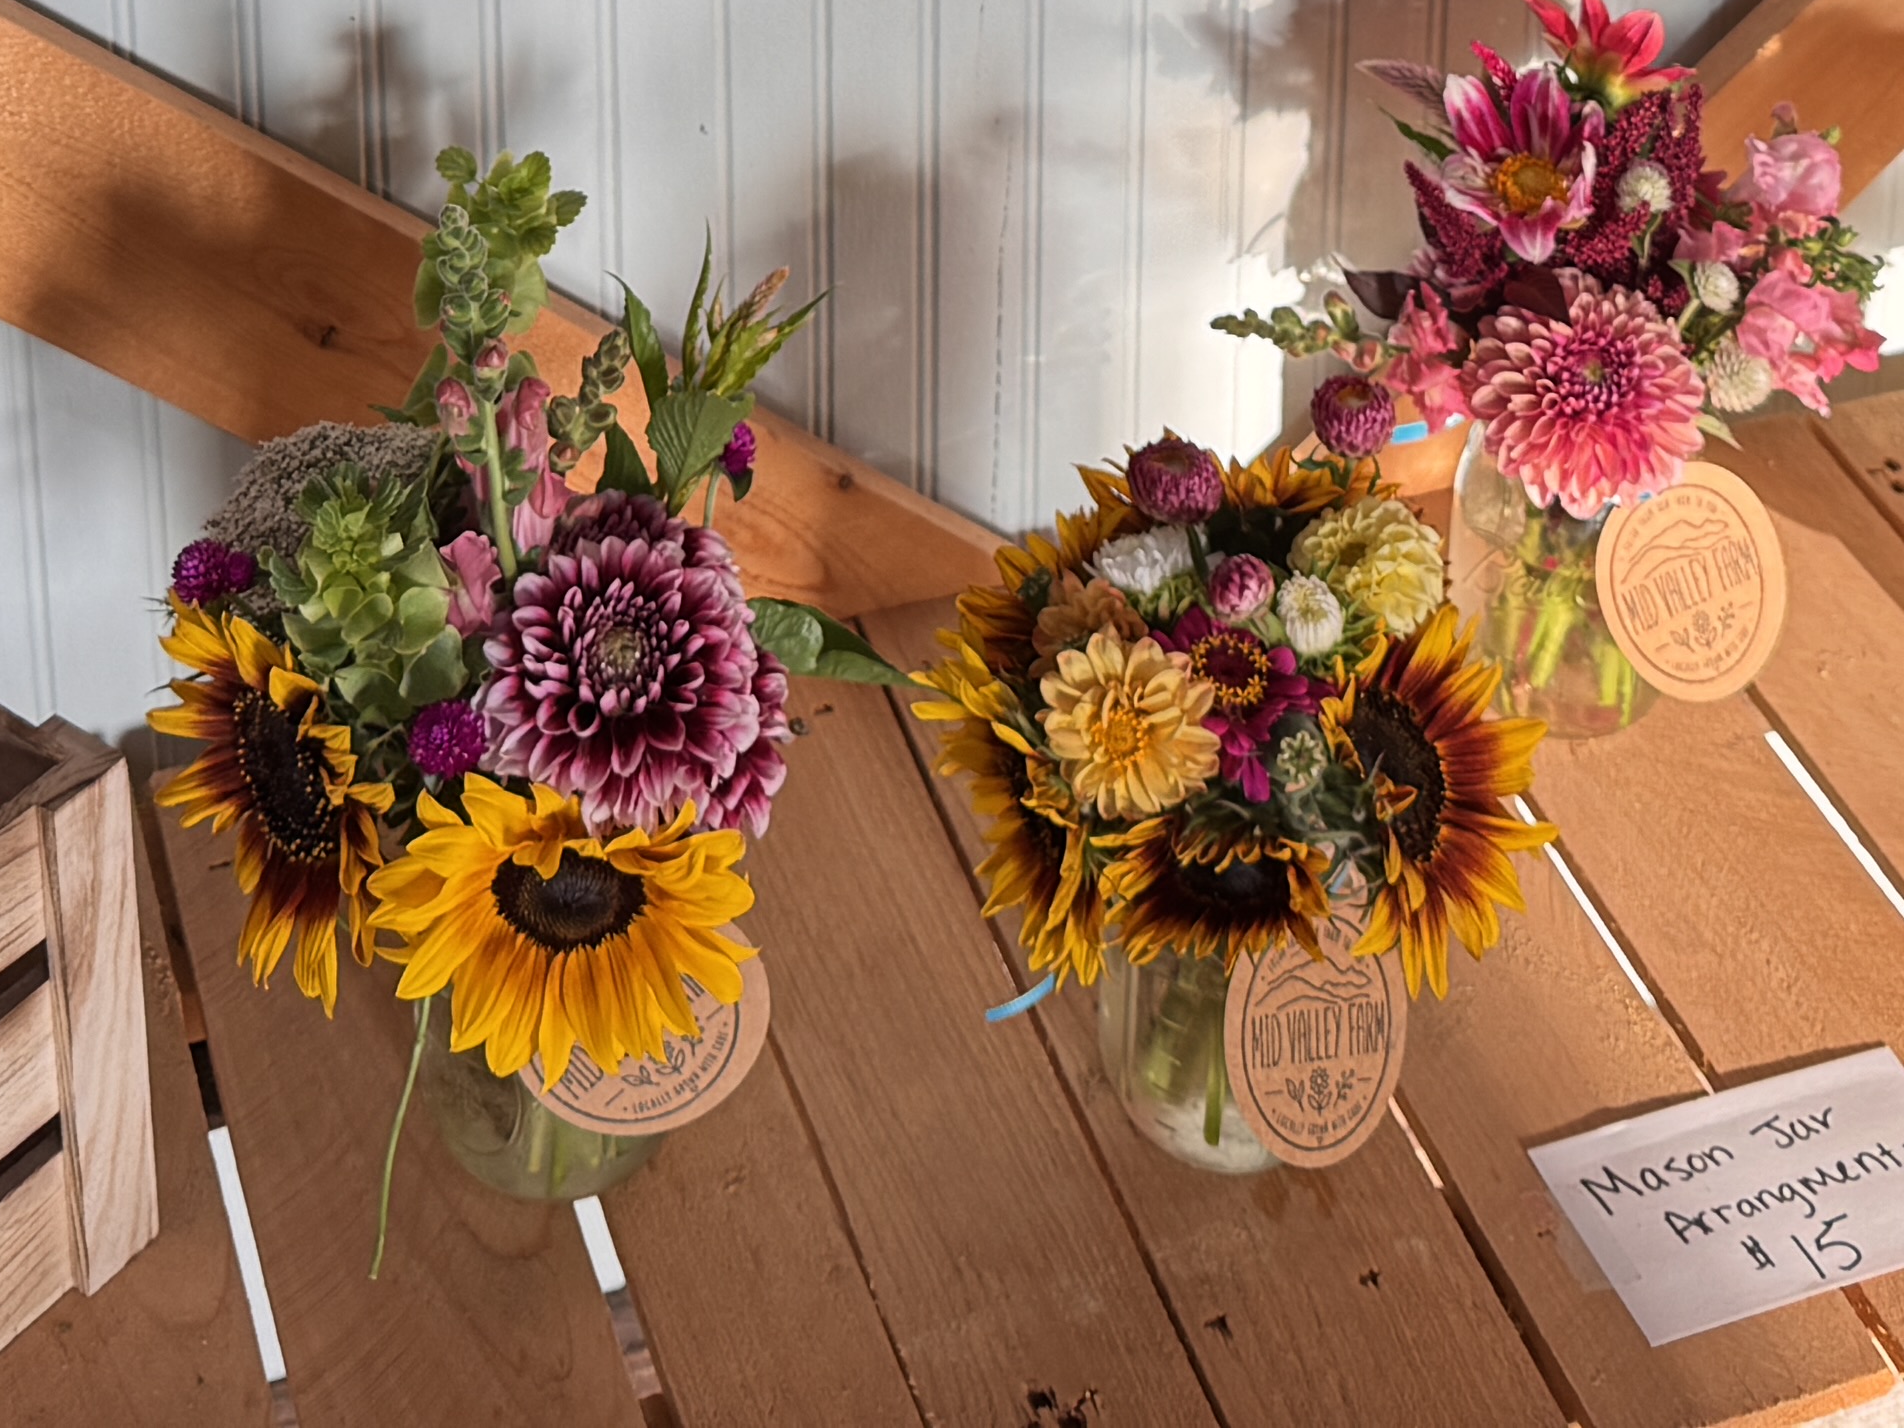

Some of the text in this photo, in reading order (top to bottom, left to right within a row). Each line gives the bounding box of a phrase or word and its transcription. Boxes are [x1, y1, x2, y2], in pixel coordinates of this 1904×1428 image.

[1652, 555, 1712, 619] VALLEY
[1711, 536, 1759, 592] FARM
[1251, 999, 1385, 1070] MID VALLEY FARM
[632, 1091, 673, 1115] LOCALLY
[1580, 1106, 1833, 1216] Mason Jar
